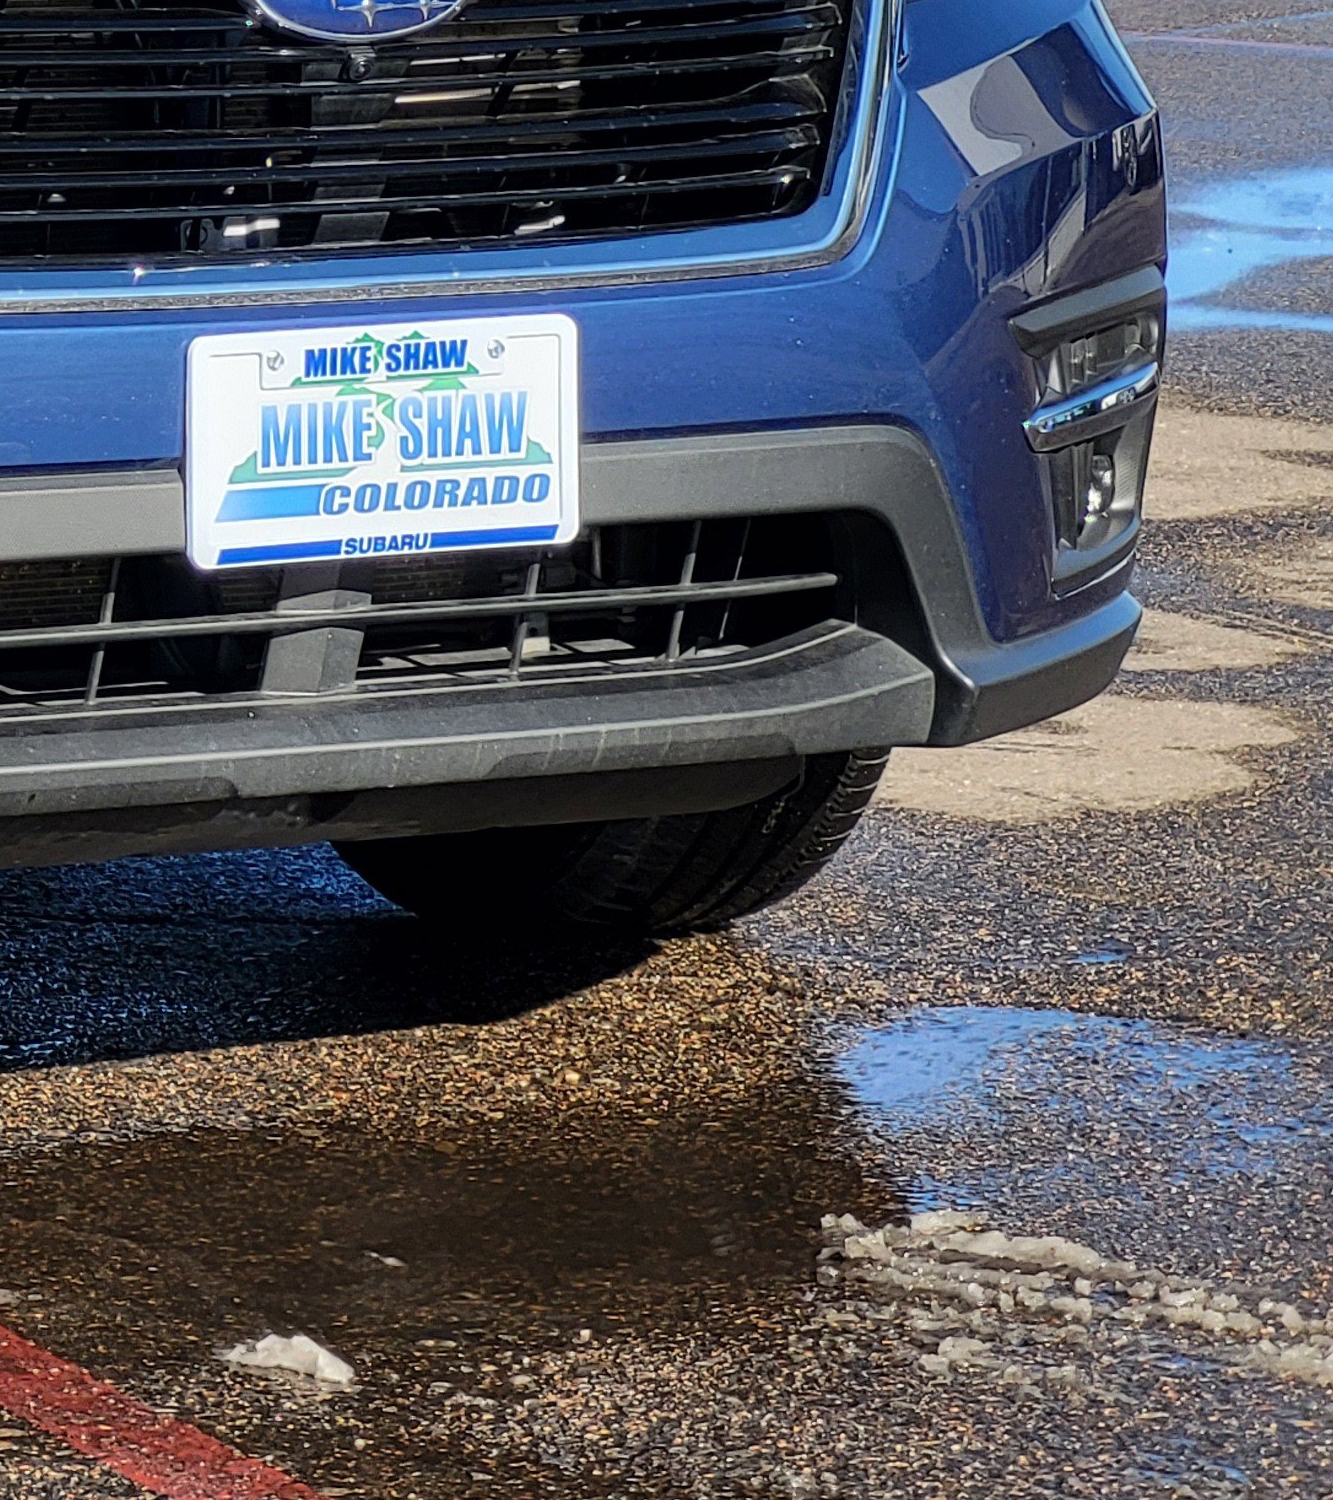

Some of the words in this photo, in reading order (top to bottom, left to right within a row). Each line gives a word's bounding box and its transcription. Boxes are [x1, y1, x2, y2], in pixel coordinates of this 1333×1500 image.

[304, 347, 373, 379] MIKE
[385, 339, 468, 373] SHAW
[260, 398, 373, 469] MIKE
[398, 390, 528, 462] SHAW
[321, 473, 551, 516] COLORADO
[343, 533, 430, 555] SUBARU
